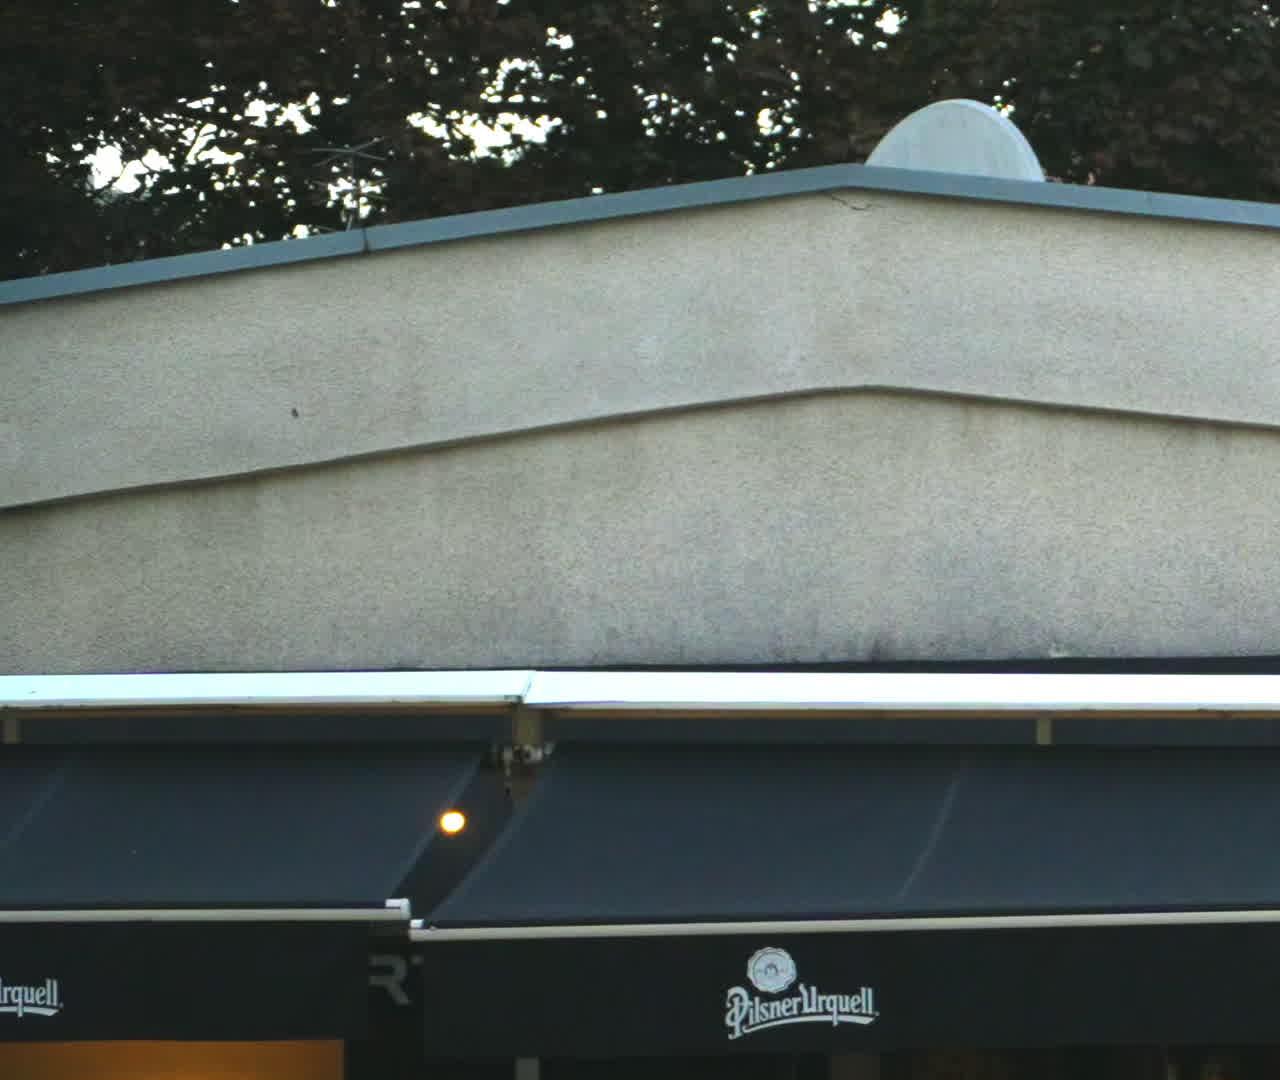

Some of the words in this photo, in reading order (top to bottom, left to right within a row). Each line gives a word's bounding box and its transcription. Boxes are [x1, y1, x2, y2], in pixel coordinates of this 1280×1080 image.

[0, 976, 58, 1016] rquell
[725, 986, 800, 1040] Pilsner
[799, 983, 873, 1026] Urquell
